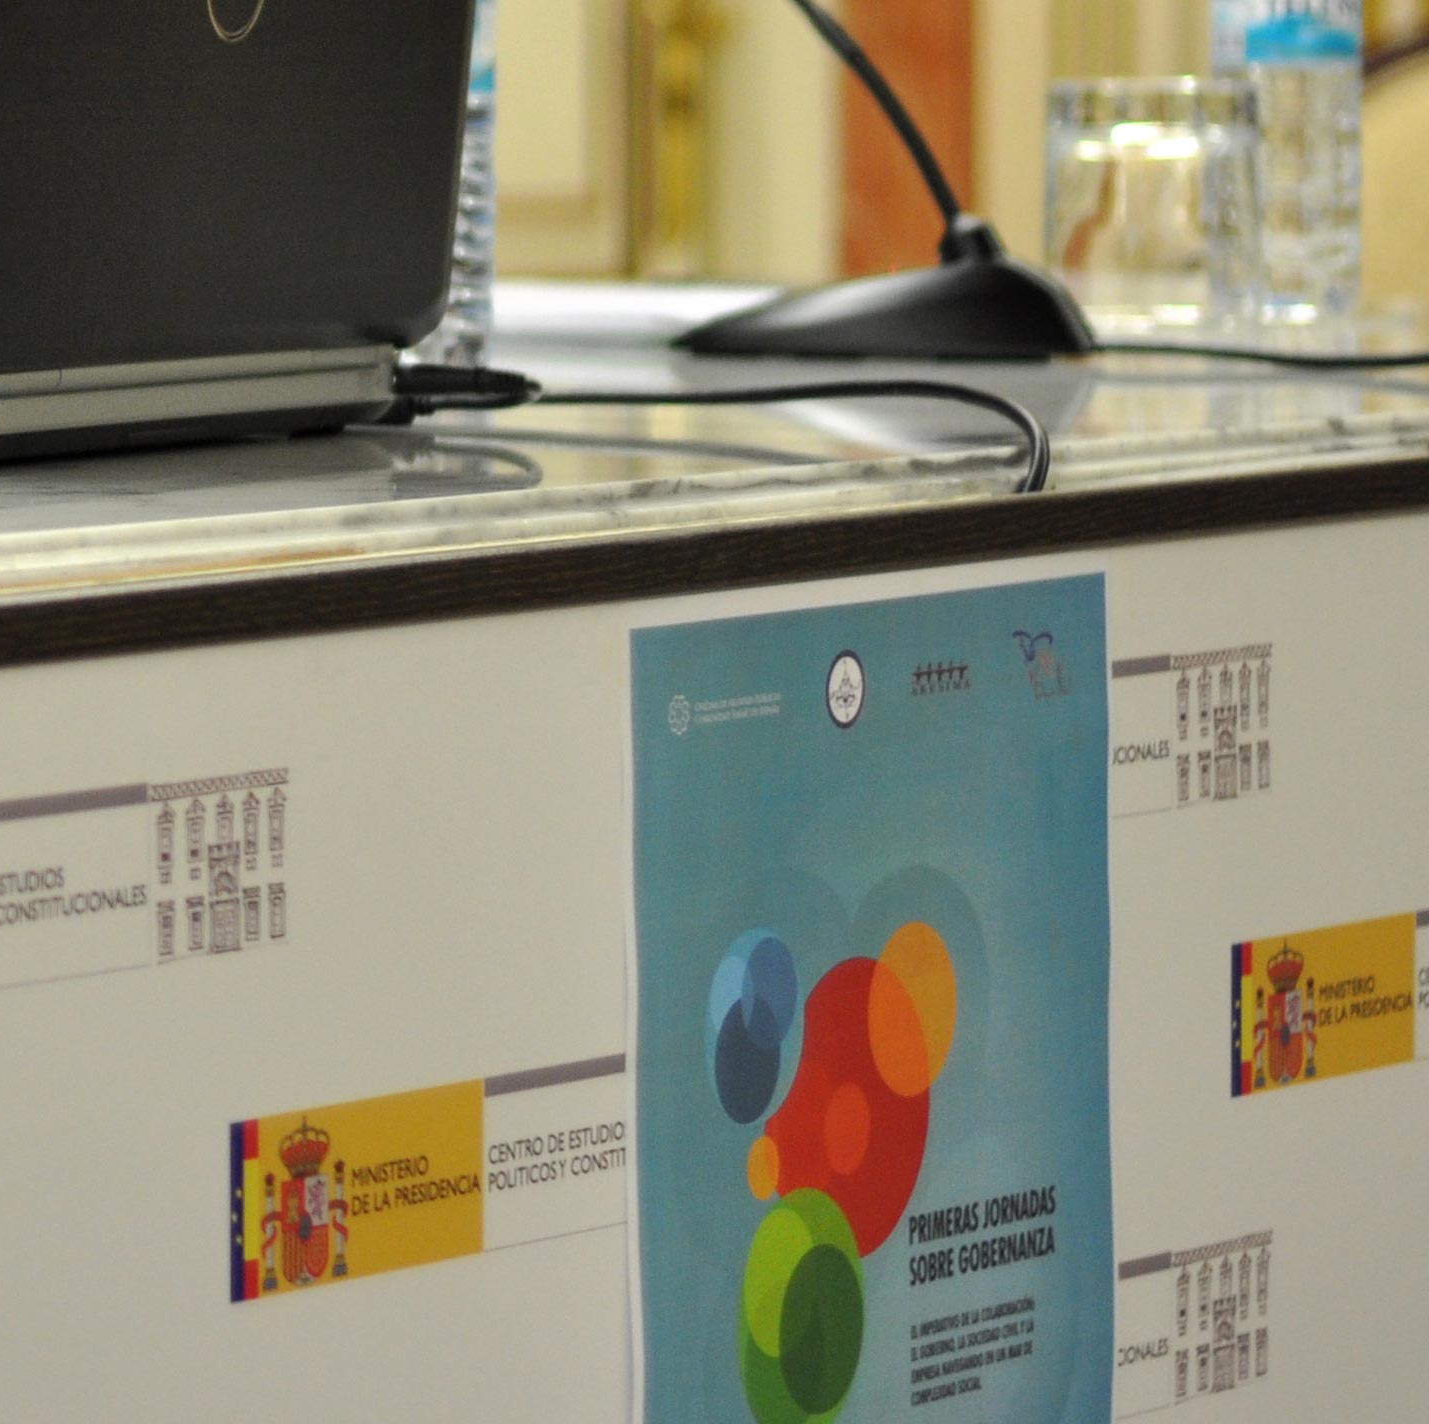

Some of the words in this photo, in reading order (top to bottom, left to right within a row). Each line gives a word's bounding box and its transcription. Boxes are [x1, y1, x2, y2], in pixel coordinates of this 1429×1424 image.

[488, 1137, 543, 1165] CENTRO
[547, 1132, 565, 1154] DE
[569, 1121, 626, 1151] ESTUDIO
[352, 1154, 429, 1187] MINISTERIO
[555, 1160, 568, 1180] Y
[352, 1192, 370, 1216] DE
[373, 1190, 391, 1212] LA
[395, 1173, 481, 1209] PRESIDENCIA
[908, 1202, 979, 1246] PRIMERAS
[983, 1185, 1056, 1229] JORNADAS
[909, 1248, 954, 1287] SOBRE
[958, 1226, 1055, 1274] GOBERNANZA
